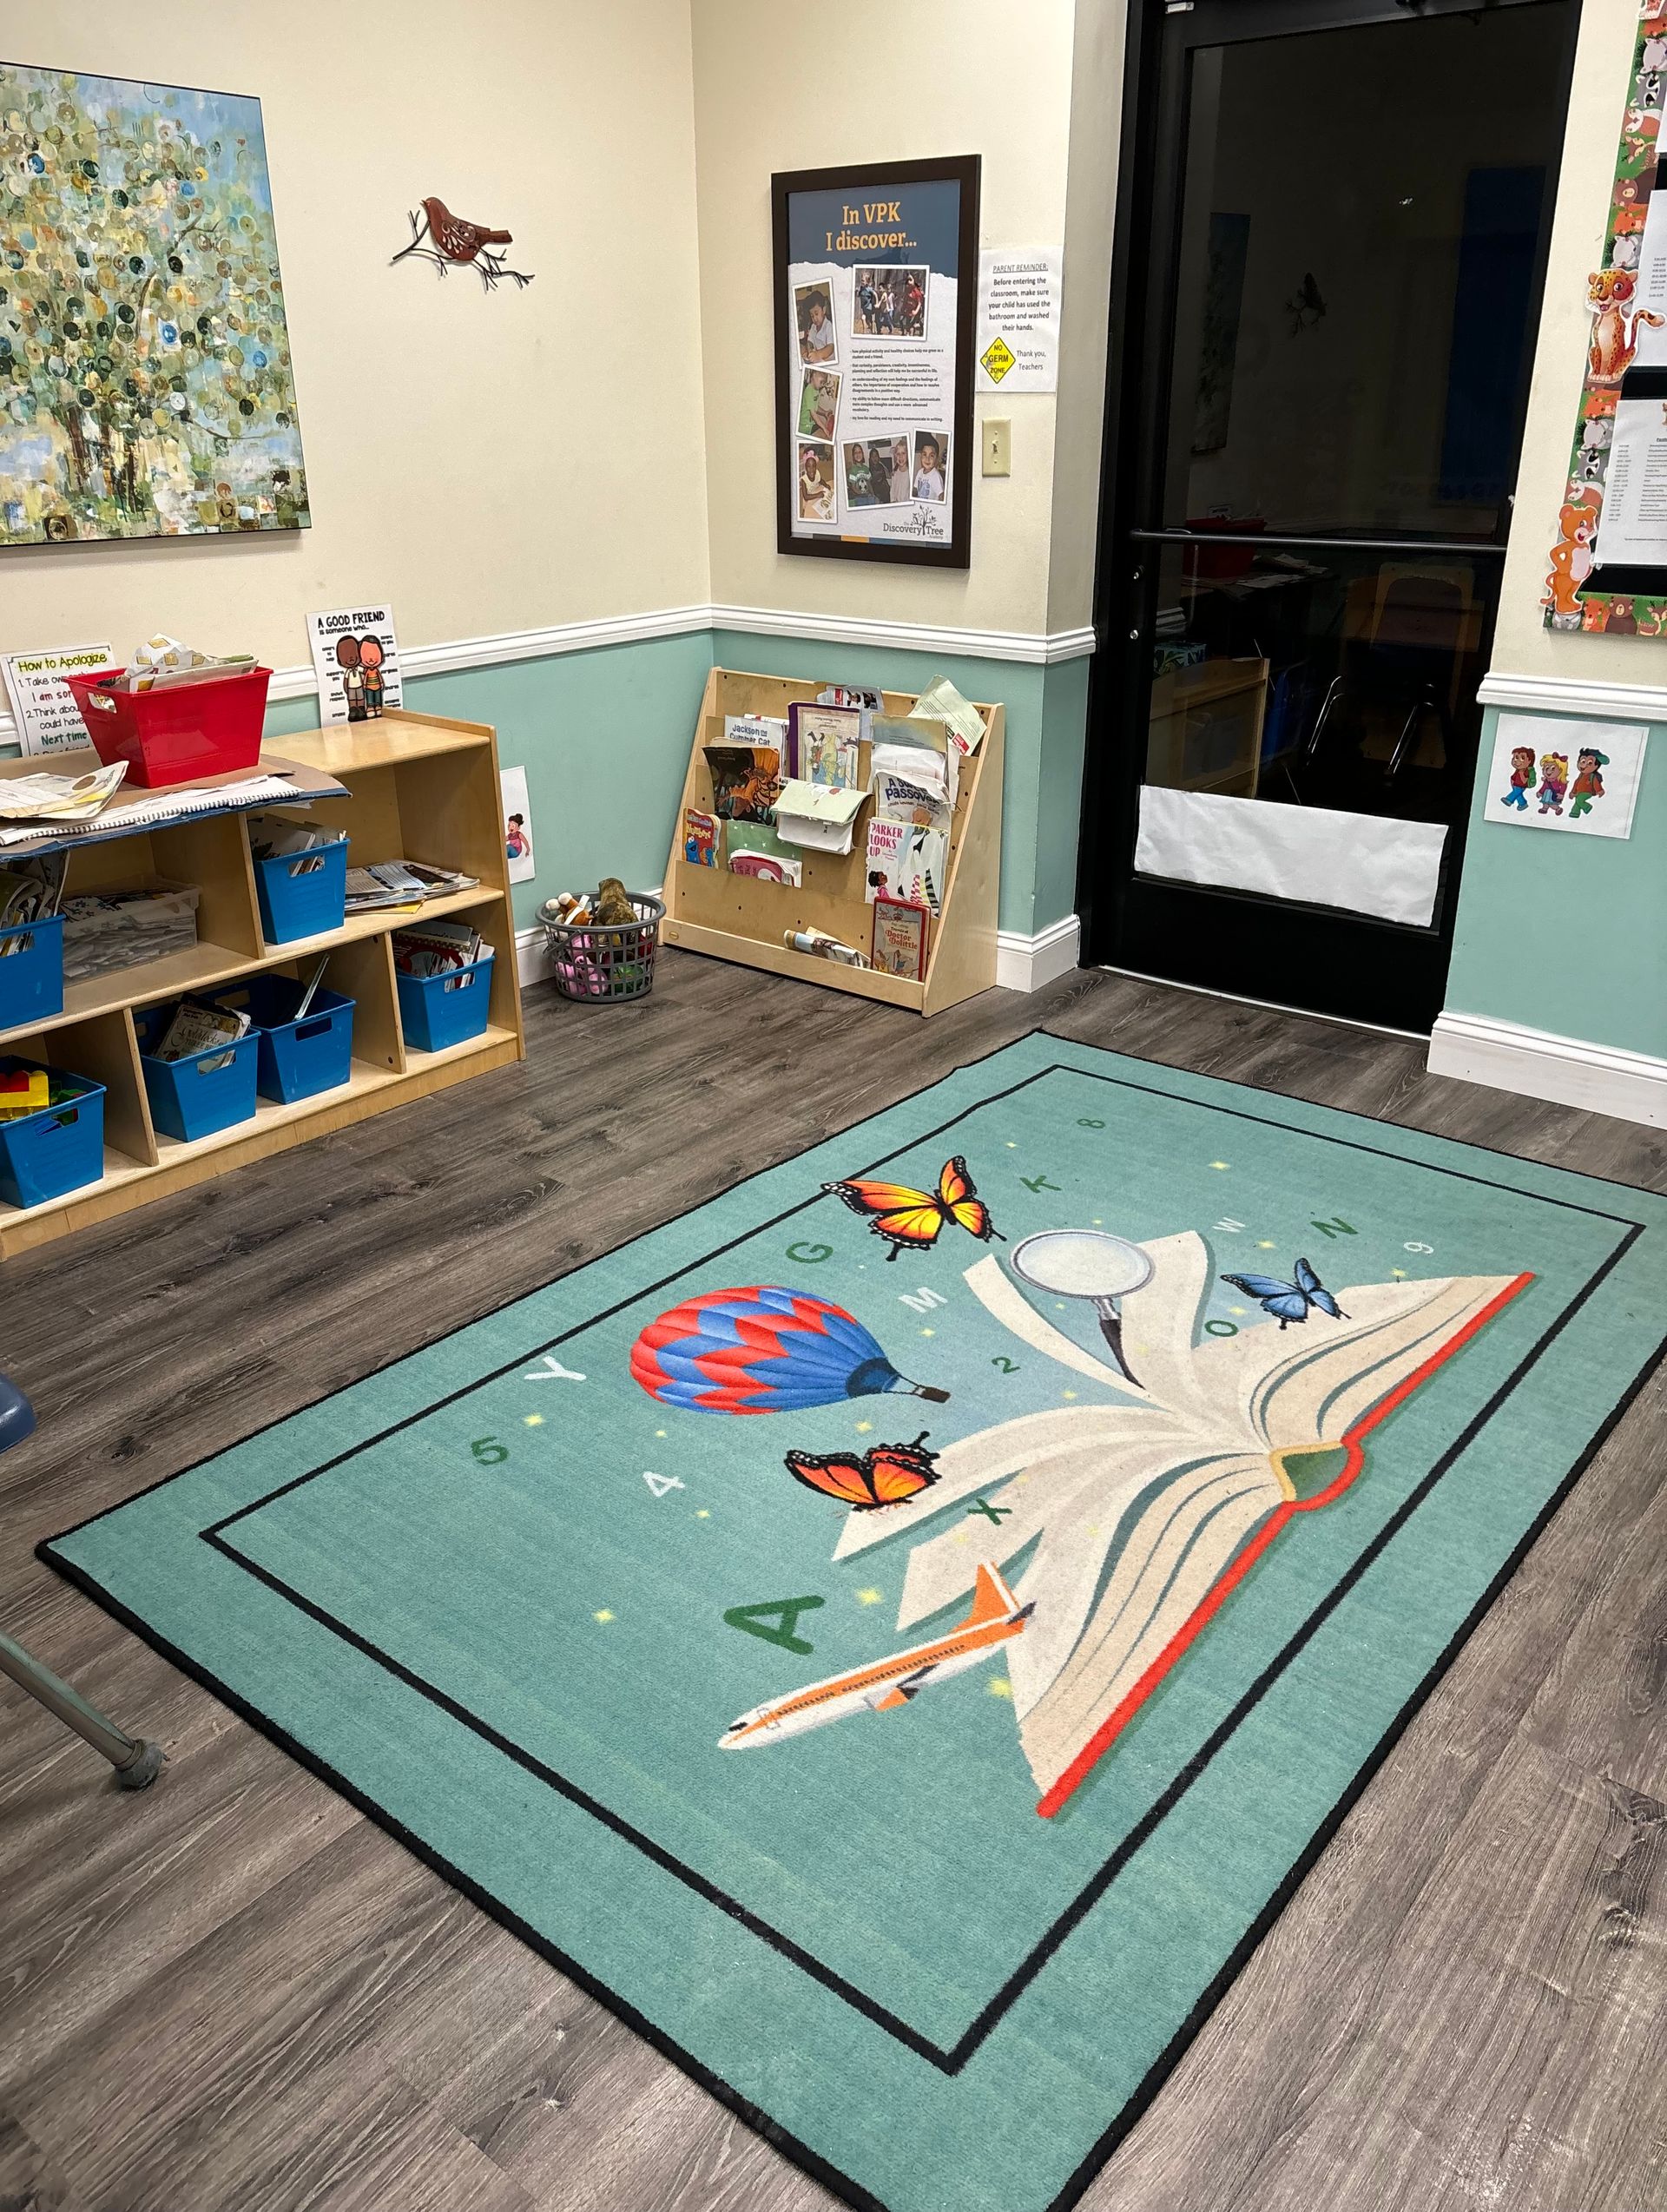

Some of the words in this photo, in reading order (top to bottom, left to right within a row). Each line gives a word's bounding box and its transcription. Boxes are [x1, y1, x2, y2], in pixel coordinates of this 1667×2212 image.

[842, 205, 860, 225] In
[863, 201, 901, 223] VPK
[826, 232, 833, 251] I
[836, 230, 917, 251] discover...
[1013, 277, 1035, 285] entering
[988, 354, 1009, 363] GERM
[1034, 351, 1046, 360] you,
[883, 523, 922, 536] Discovery
[926, 526, 944, 535] Tree
[318, 618, 324, 629] A
[326, 615, 350, 627] GOOD
[352, 611, 385, 624] FRIEND
[18, 661, 42, 672] How
[45, 658, 56, 668] to
[60, 653, 107, 669] Apologize
[25, 677, 49, 686] Take
[32, 692, 36, 702] I
[57, 690, 73, 699] sor
[59, 705, 79, 714] abou
[40, 718, 62, 730] could
[64, 717, 84, 726] have
[732, 724, 760, 735] Jackson
[41, 734, 64, 746] Next
[65, 731, 87, 743] time
[888, 778, 896, 788] A
[870, 834, 897, 849] LOOKS
[870, 846, 880, 856] UP
[885, 930, 911, 941] Doctor
[889, 937, 917, 949] Dolittle
[1078, 1119, 1105, 1128] 8
[1020, 1175, 1062, 1194] K
[786, 1241, 833, 1264] G
[524, 1356, 586, 1382] Y
[992, 1356, 1020, 1373] 2
[471, 1436, 509, 1465] 5
[643, 1471, 684, 1497] 4
[968, 1498, 1012, 1525] X
[724, 1595, 825, 1656] A
